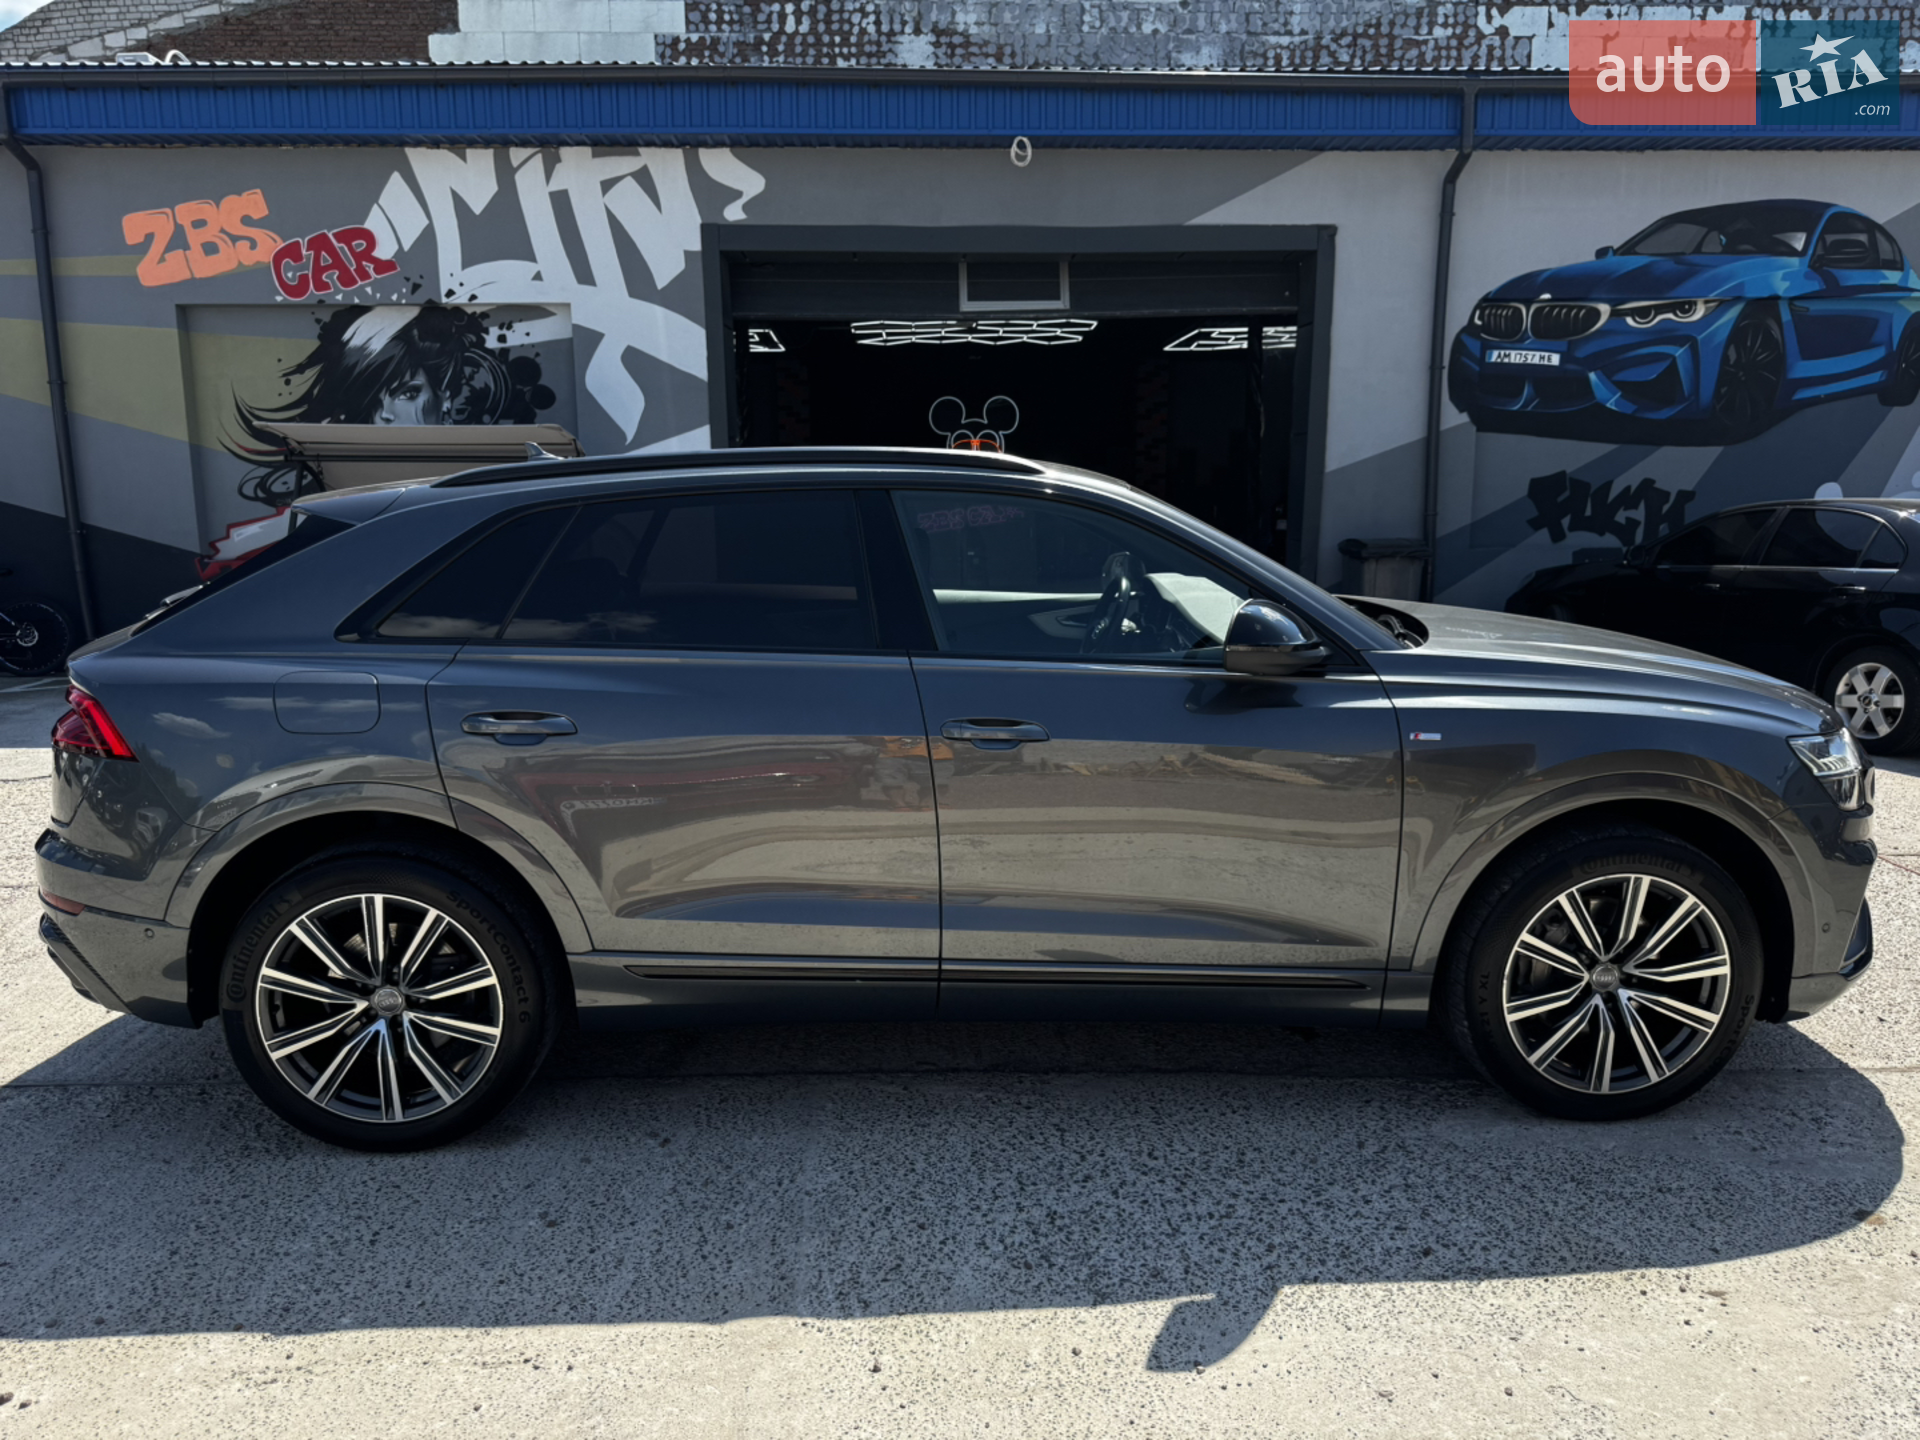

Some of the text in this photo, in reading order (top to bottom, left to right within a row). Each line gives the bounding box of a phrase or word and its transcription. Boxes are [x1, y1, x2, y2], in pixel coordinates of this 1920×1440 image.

[121, 189, 284, 288] ZBS
[271, 225, 399, 301] CAR
[226, 903, 282, 1004] Continental
[446, 889, 530, 1005] SportContact
